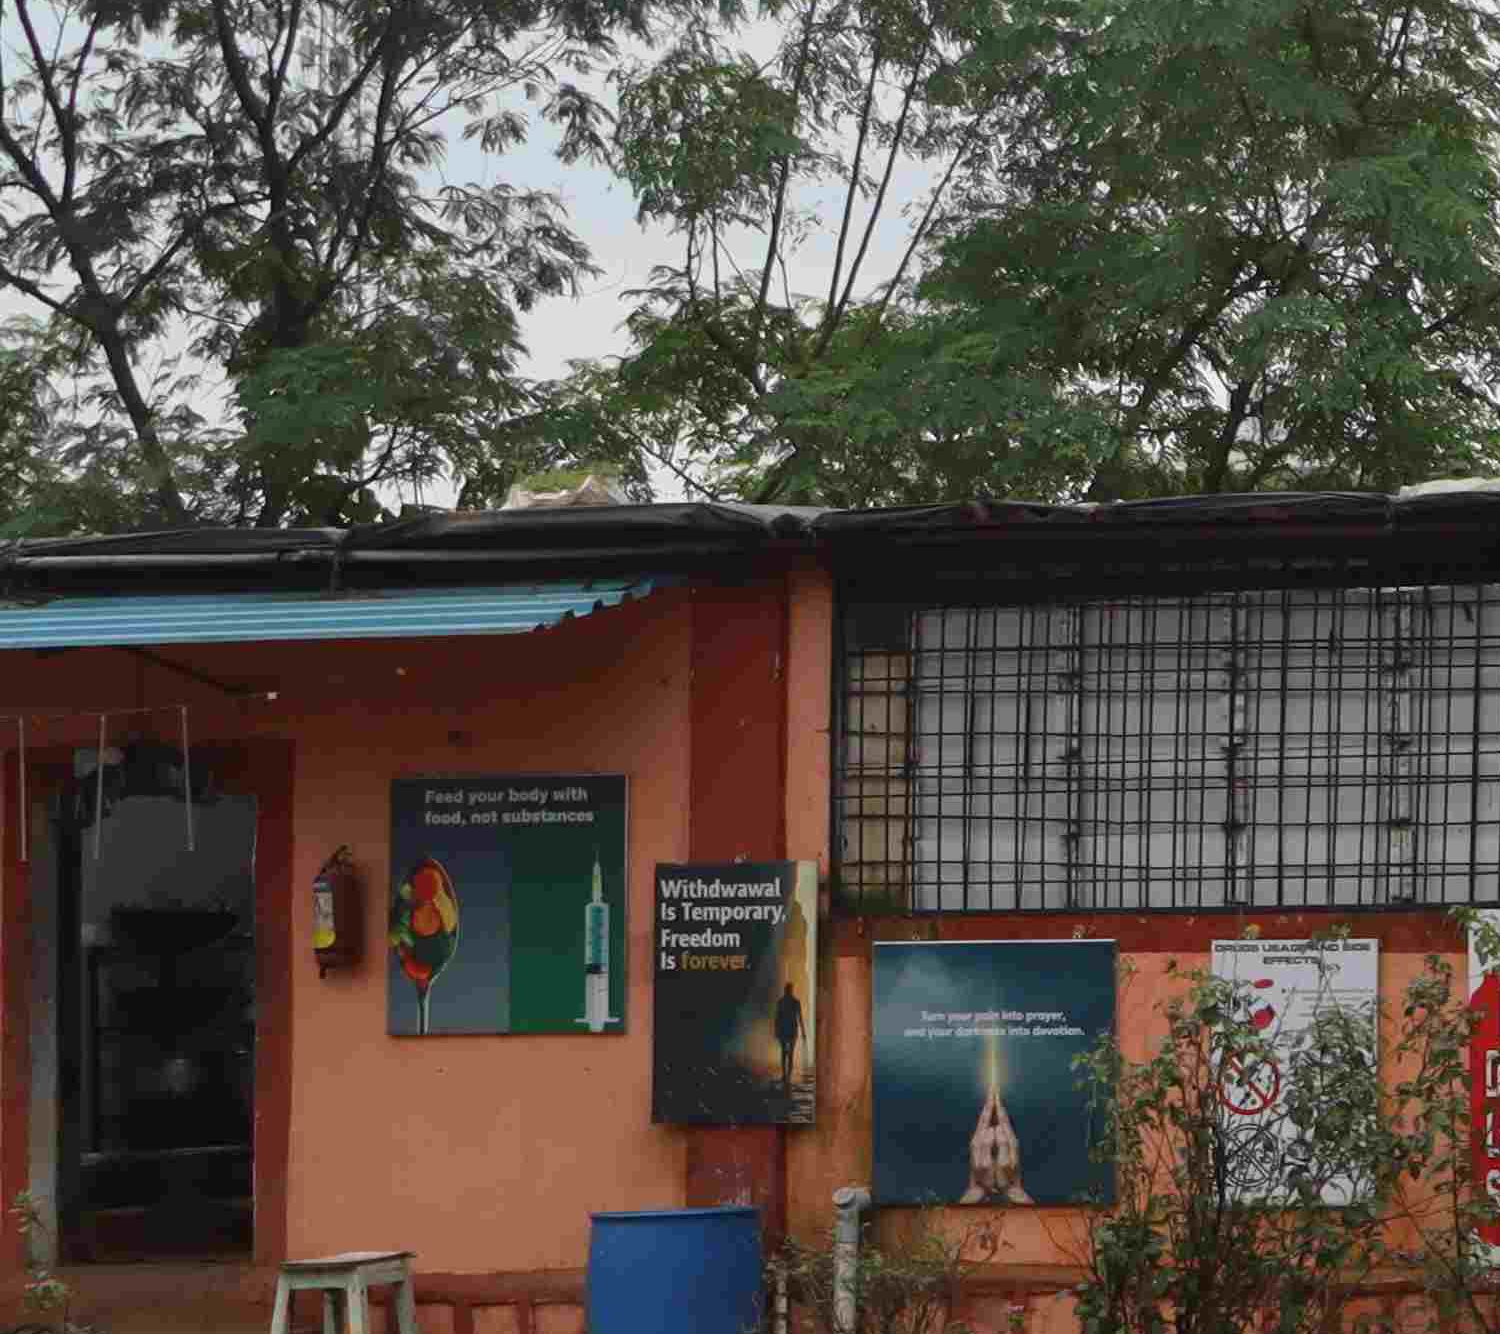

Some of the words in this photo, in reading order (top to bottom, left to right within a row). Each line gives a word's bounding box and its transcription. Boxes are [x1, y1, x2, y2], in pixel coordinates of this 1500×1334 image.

[425, 788, 463, 803] Feed
[468, 789, 504, 805] your
[508, 787, 549, 805] body
[553, 786, 588, 802] with
[425, 811, 466, 826] food,
[471, 811, 498, 823] not
[502, 809, 594, 823] substances
[661, 877, 781, 898] Withdwawal
[661, 902, 676, 921] Is
[681, 902, 786, 926] Temporary,
[661, 928, 741, 947] Freedom
[1215, 943, 1259, 953] DRUGS
[661, 951, 676, 970] Is
[681, 951, 751, 970] forever.
